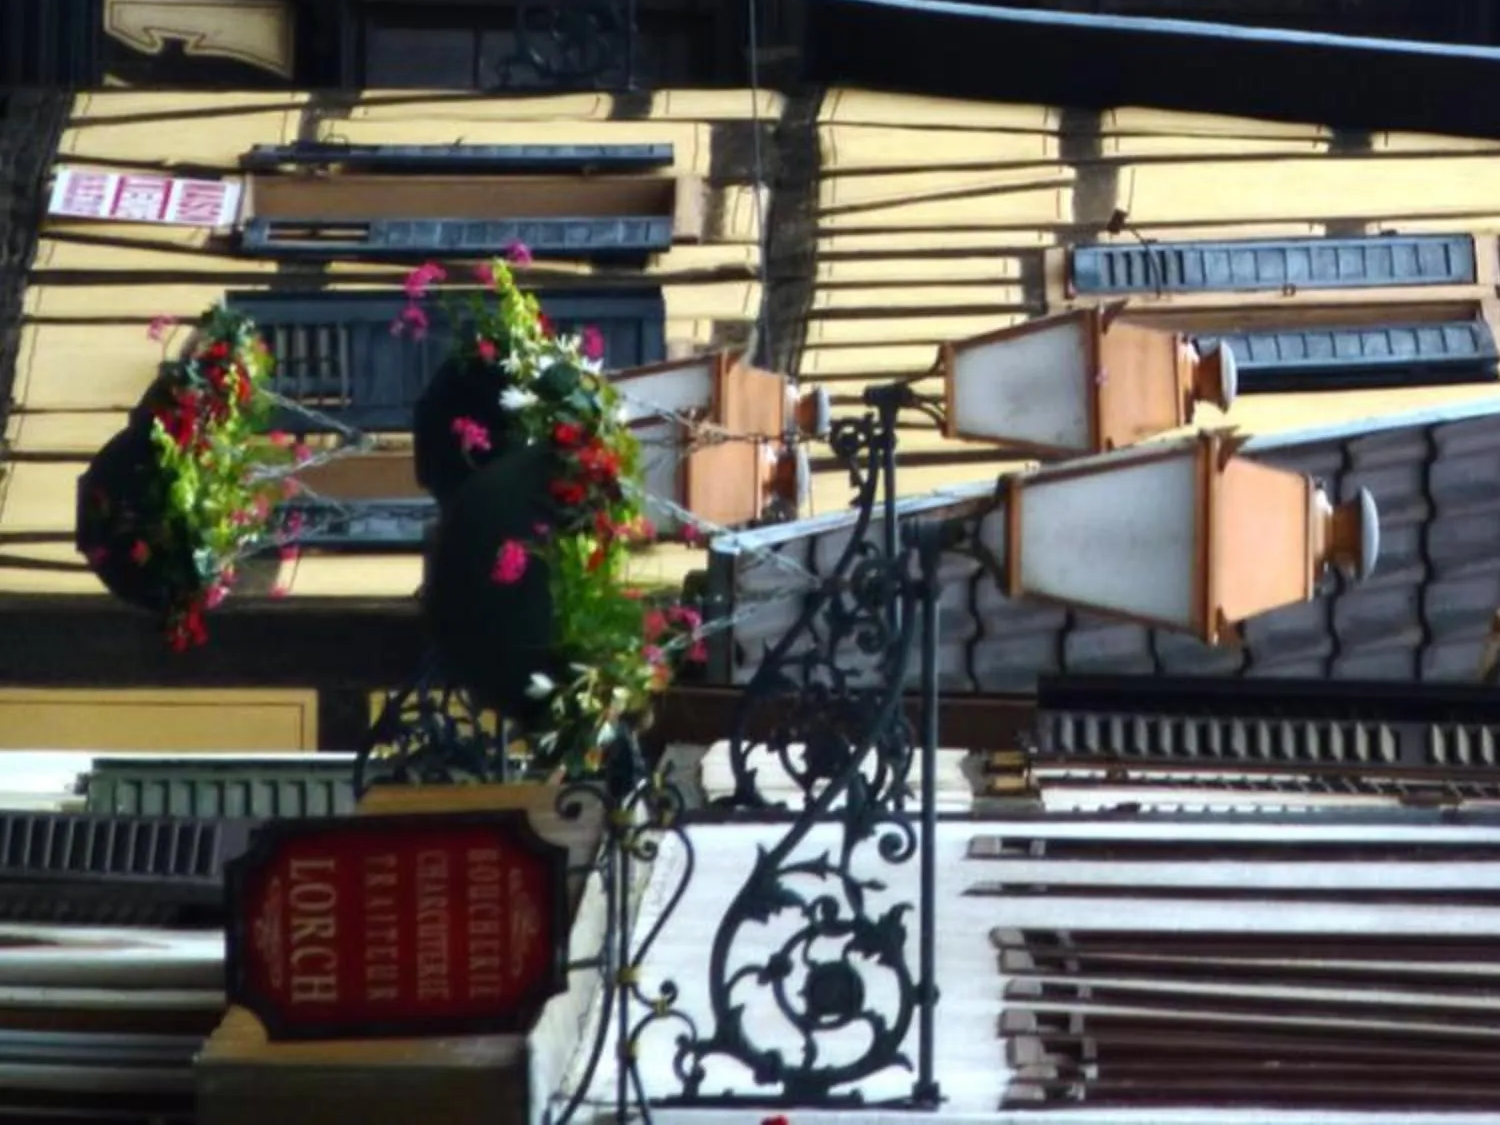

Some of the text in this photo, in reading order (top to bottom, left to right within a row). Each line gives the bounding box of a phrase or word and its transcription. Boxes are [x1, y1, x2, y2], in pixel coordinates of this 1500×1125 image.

[288, 857, 337, 1003] LORCH
[365, 853, 399, 1000] TRAITEUR
[416, 849, 449, 1002] CHARCUTERIE
[467, 848, 501, 999] BOUCHERIE
